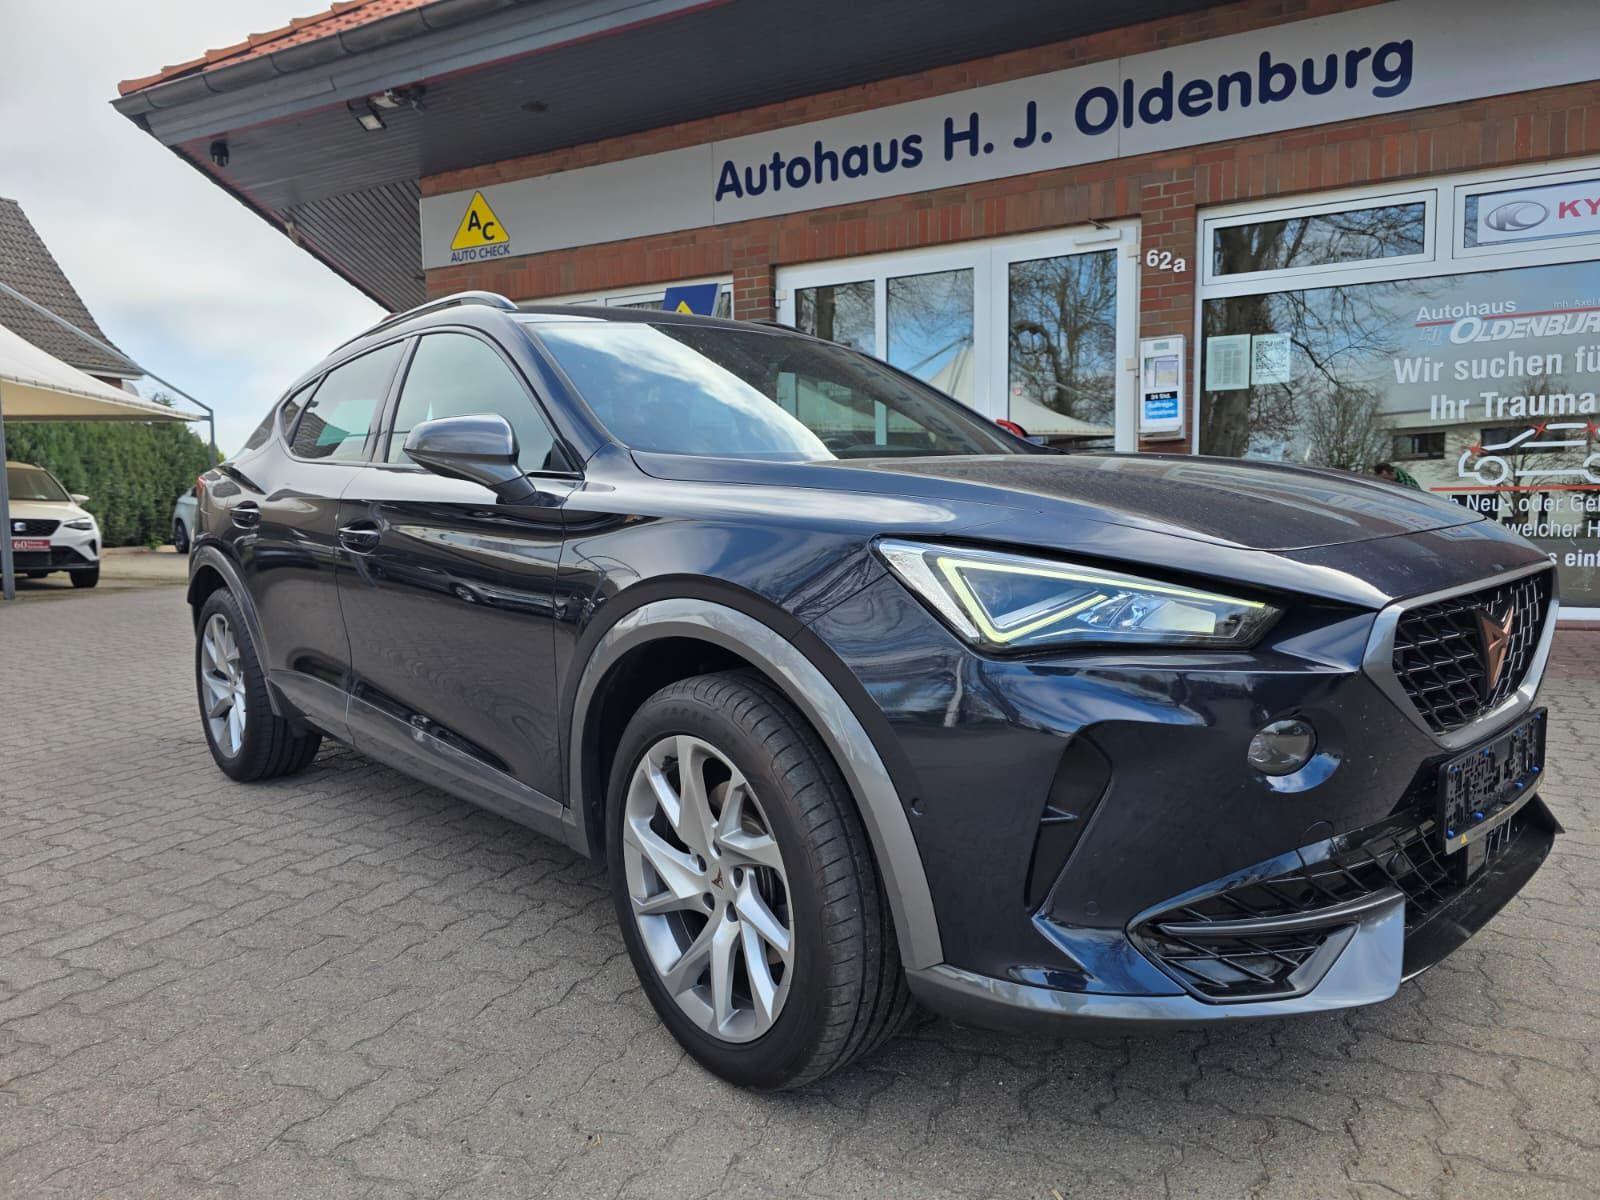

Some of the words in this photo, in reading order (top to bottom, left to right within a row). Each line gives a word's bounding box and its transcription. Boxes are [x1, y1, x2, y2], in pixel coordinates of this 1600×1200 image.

[715, 134, 923, 202] Autohaus
[943, 112, 994, 162] H.
[1013, 101, 1052, 149] J.
[1074, 38, 1414, 136] Oldenburg
[451, 249, 477, 262] AUTO
[479, 244, 510, 258] CHECK
[1145, 249, 1187, 272] 62a
[1416, 300, 1517, 322] Autohaus
[1393, 356, 1444, 384] Wir
[1454, 351, 1562, 381] suchen
[1430, 394, 1470, 420] Ihr
[1480, 392, 1596, 418] Trauma
[1518, 494, 1563, 512] oder
[1505, 520, 1582, 537] welcher
